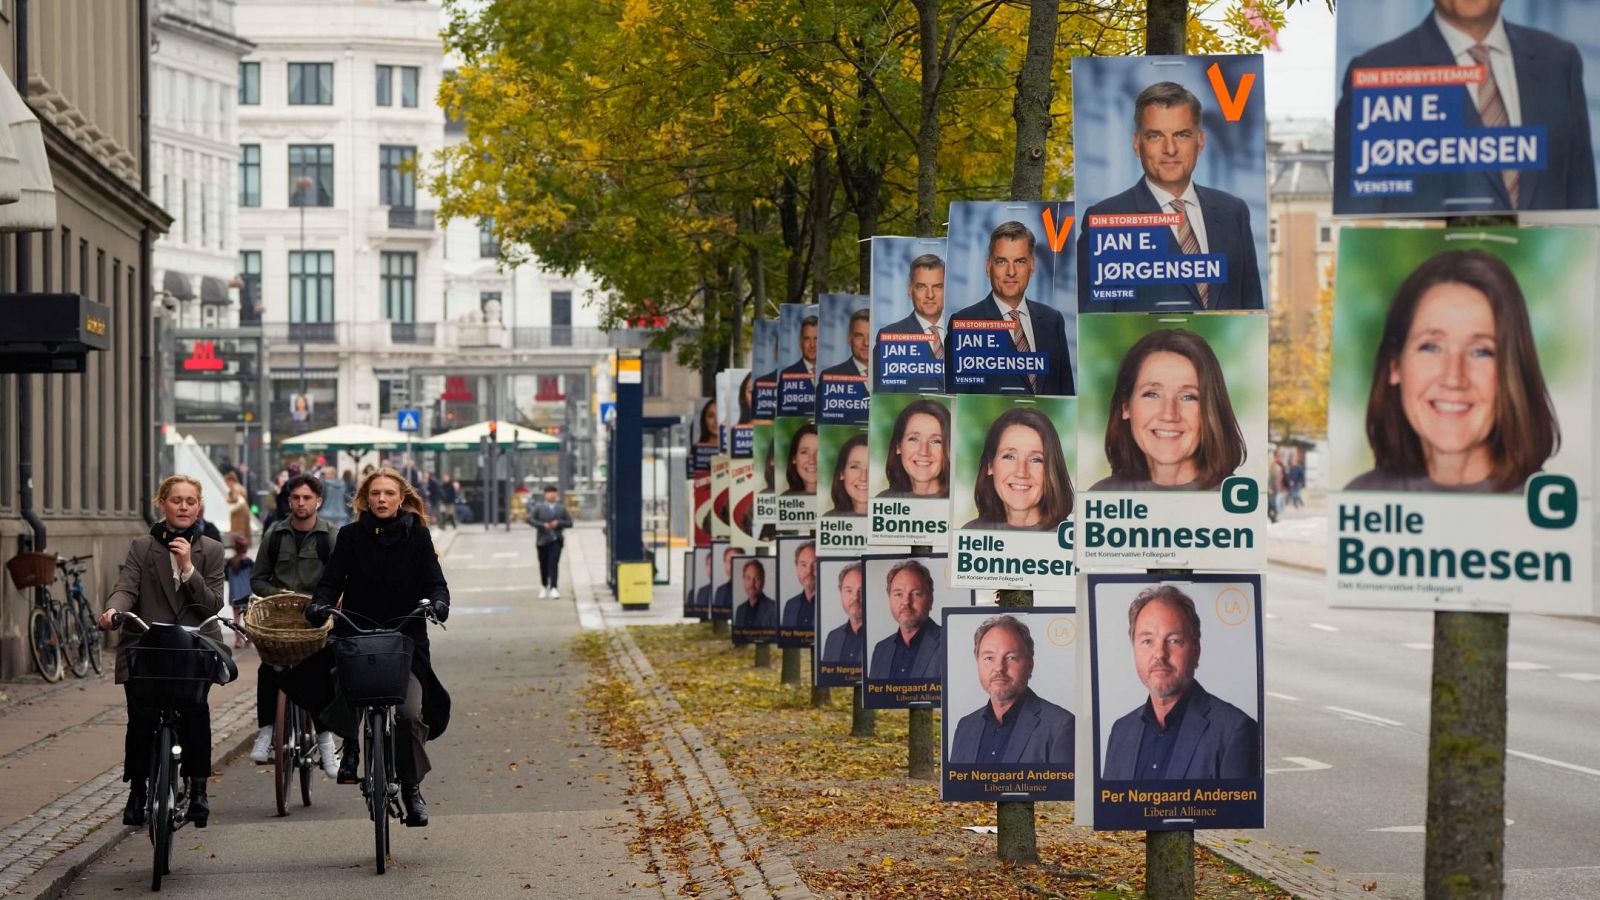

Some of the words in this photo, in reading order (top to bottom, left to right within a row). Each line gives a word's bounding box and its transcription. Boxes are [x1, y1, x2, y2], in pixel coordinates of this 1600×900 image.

[1356, 72, 1379, 84] DIN
[1381, 69, 1482, 84] STORBYSTEMME
[1206, 62, 1256, 122] V
[1357, 95, 1412, 130] JAN
[1422, 94, 1447, 121] E.
[1356, 135, 1538, 174] JØRGENSEN
[1354, 180, 1413, 193] VENSTRE
[1092, 217, 1108, 225] DIN
[1110, 215, 1180, 225] STORBYSTEMME
[1041, 208, 1075, 252] V
[1094, 232, 1132, 256] JAN
[1139, 232, 1157, 250] E.
[1094, 260, 1220, 285] JØRGENSEN
[1093, 290, 1134, 298] VENSTRE
[966, 321, 1016, 329] STORBYSTEMME
[956, 334, 983, 351] JAN
[987, 334, 1000, 348] E.
[882, 344, 906, 358] JAN
[910, 344, 920, 356] E.
[956, 356, 1045, 373] JØRGENSEN
[783, 380, 798, 392] JAN
[824, 384, 844, 396] JAN
[848, 384, 857, 394] E.
[779, 499, 804, 508] Helle
[873, 502, 910, 515] Helle
[1086, 499, 1148, 519] Helle
[780, 510, 816, 520] Bonn
[1338, 504, 1424, 534] Helle
[820, 520, 852, 531] Helle
[872, 516, 950, 534] Bonnes
[820, 532, 867, 546] Bonn
[1086, 522, 1254, 548] Bonnesen
[958, 536, 1004, 552] Helle
[1142, 551, 1176, 559] Folkeparti
[1338, 537, 1572, 582] Bonnesen
[1224, 600, 1241, 613] LA
[868, 684, 883, 693] Per
[886, 684, 927, 694] Nørgaard
[949, 770, 968, 780] Per
[972, 770, 1024, 782] Nørgaard
[1026, 770, 1075, 780] Anderse
[984, 783, 1012, 792] Liberal
[1014, 783, 1047, 792] Alliance
[1101, 790, 1125, 803] Per
[1128, 788, 1191, 805] Nørgaard
[1193, 788, 1257, 801] Andersen
[1144, 806, 1177, 817] Liberal
[1180, 806, 1217, 817] Alliance
